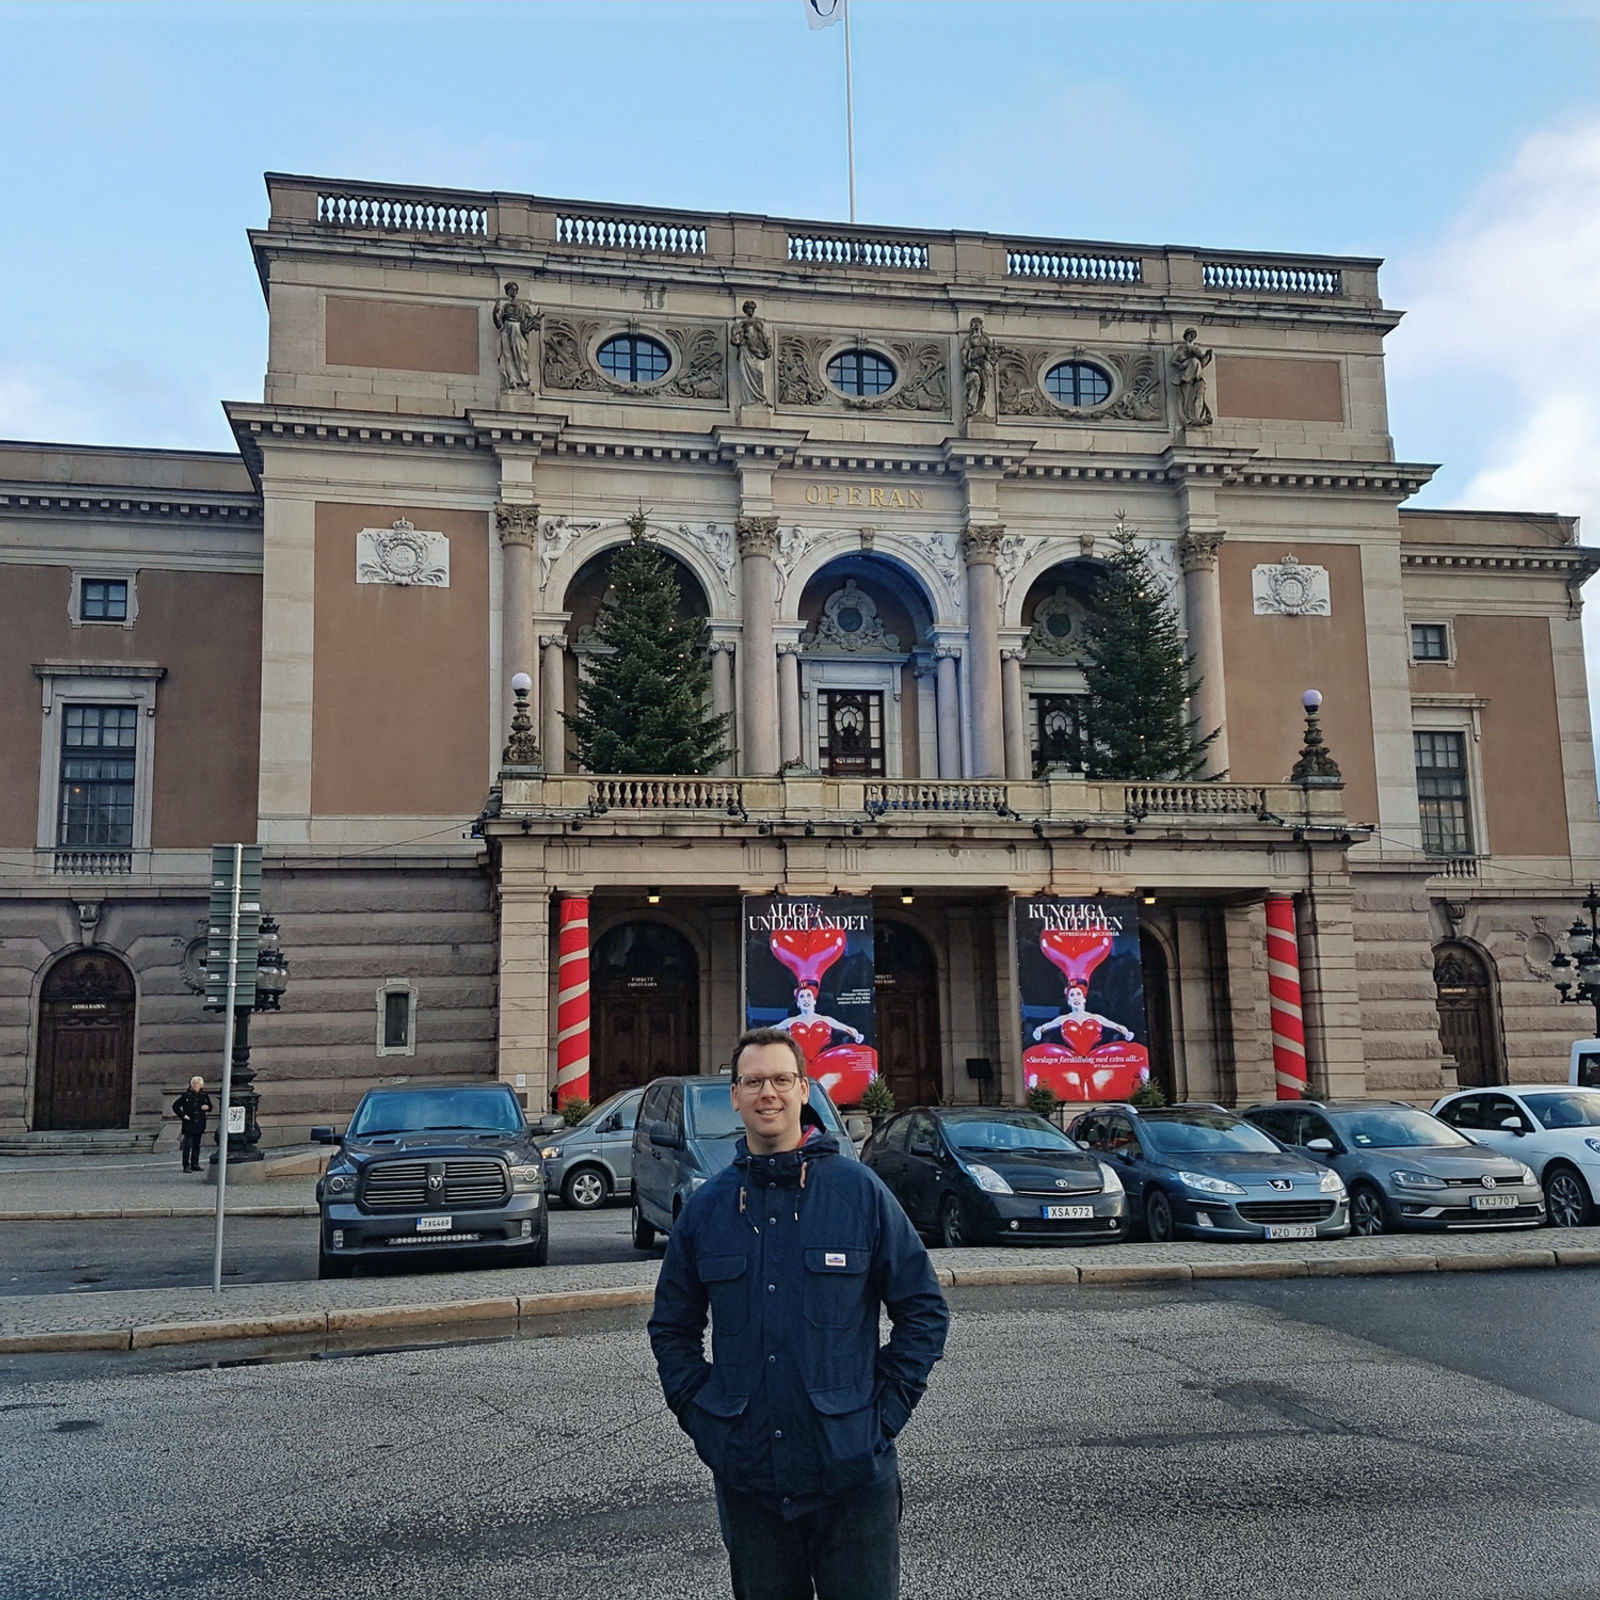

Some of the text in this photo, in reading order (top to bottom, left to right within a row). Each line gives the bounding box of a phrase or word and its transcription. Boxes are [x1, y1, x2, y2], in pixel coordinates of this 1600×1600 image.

[805, 485, 926, 509] OPERAN
[768, 903, 814, 918] ALICE
[1028, 904, 1105, 920] KUNGLIGA
[748, 915, 868, 931] UNDERLANDET
[1044, 916, 1123, 931] BALETTEN
[1480, 1196, 1515, 1206] KXJ 707
[1051, 1207, 1090, 1217] XSA 972
[1296, 1227, 1315, 1237] 773
